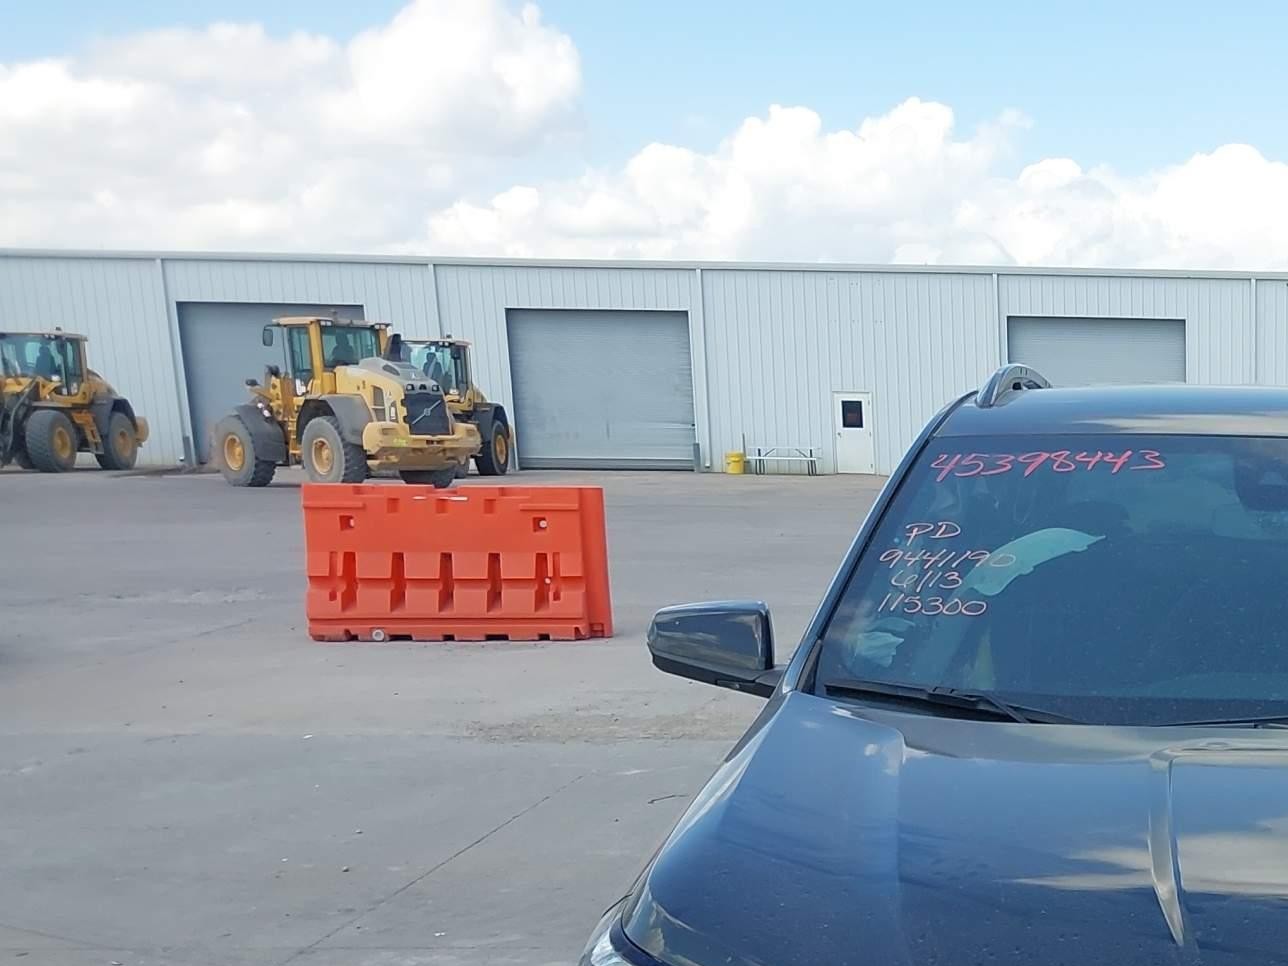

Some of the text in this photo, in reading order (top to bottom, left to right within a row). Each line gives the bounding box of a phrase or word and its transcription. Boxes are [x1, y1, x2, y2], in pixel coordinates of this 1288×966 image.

[930, 450, 1165, 482] 45398443
[905, 521, 961, 546] PD
[877, 593, 987, 616] 115300
